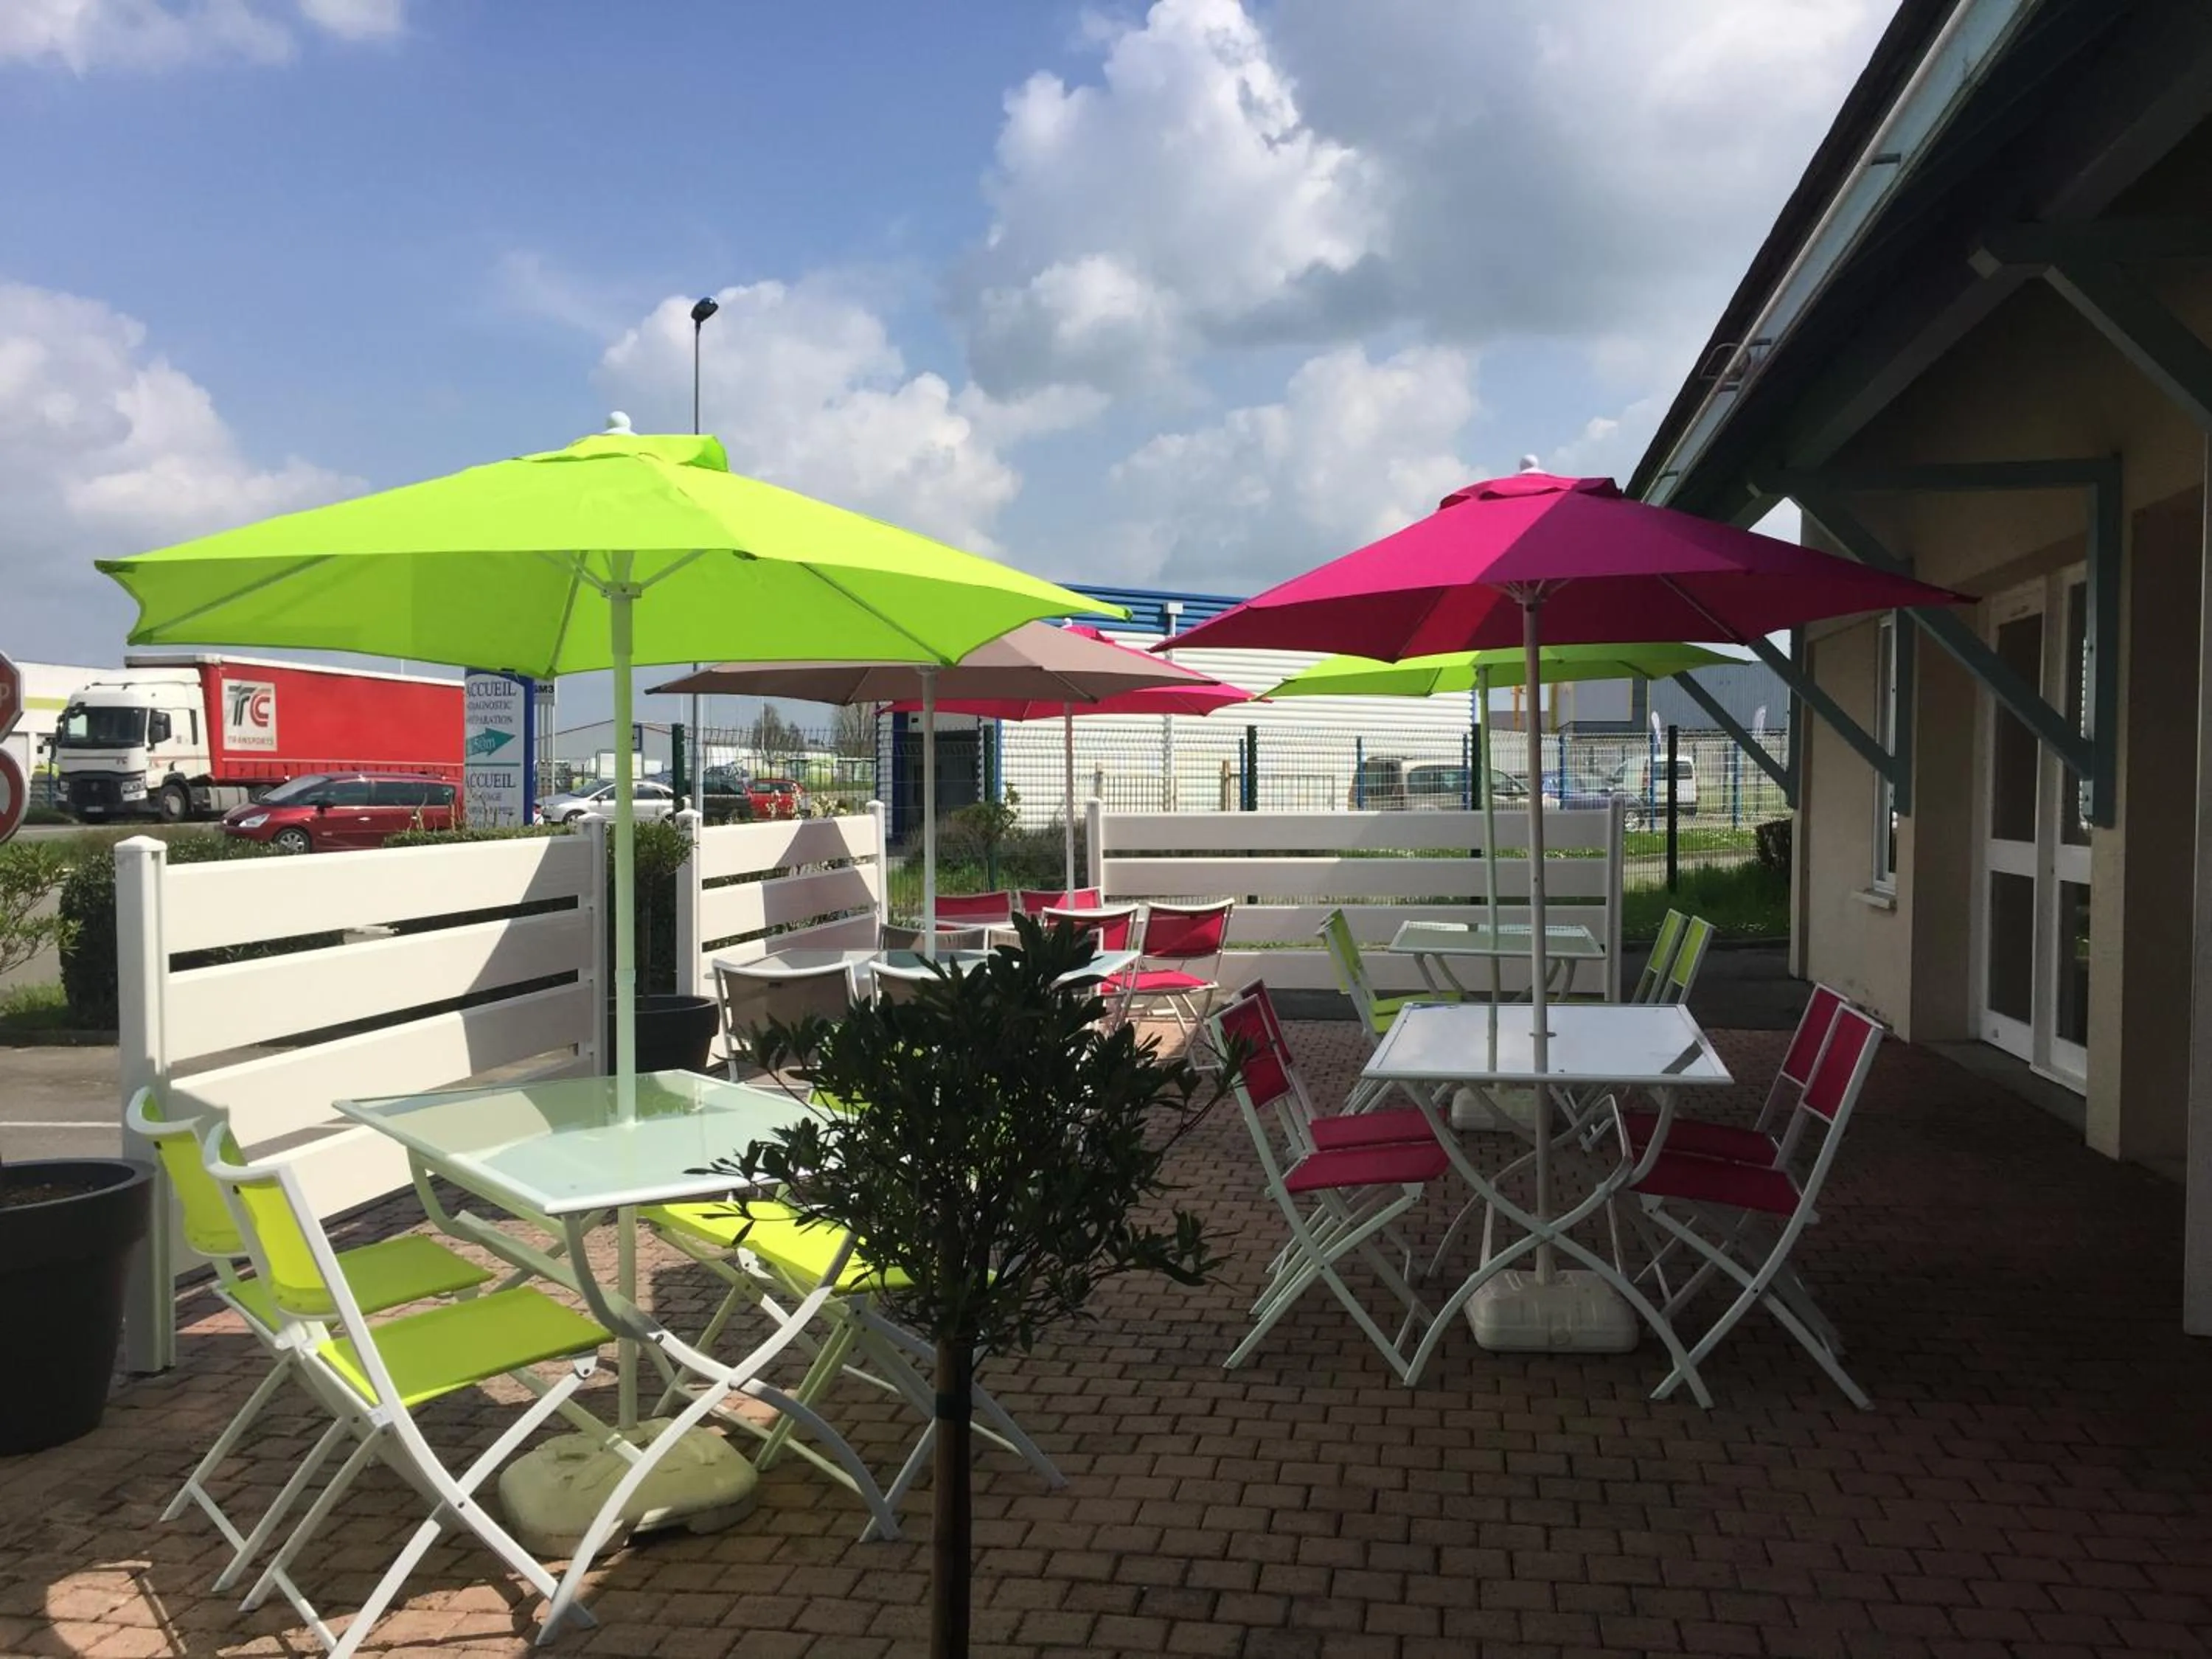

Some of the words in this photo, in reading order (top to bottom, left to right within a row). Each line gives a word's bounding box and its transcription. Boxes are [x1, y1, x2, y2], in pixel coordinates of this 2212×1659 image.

[466, 681, 516, 697] ACCUEIL
[227, 685, 272, 728] TC
[466, 772, 517, 788] ACCUEIL
